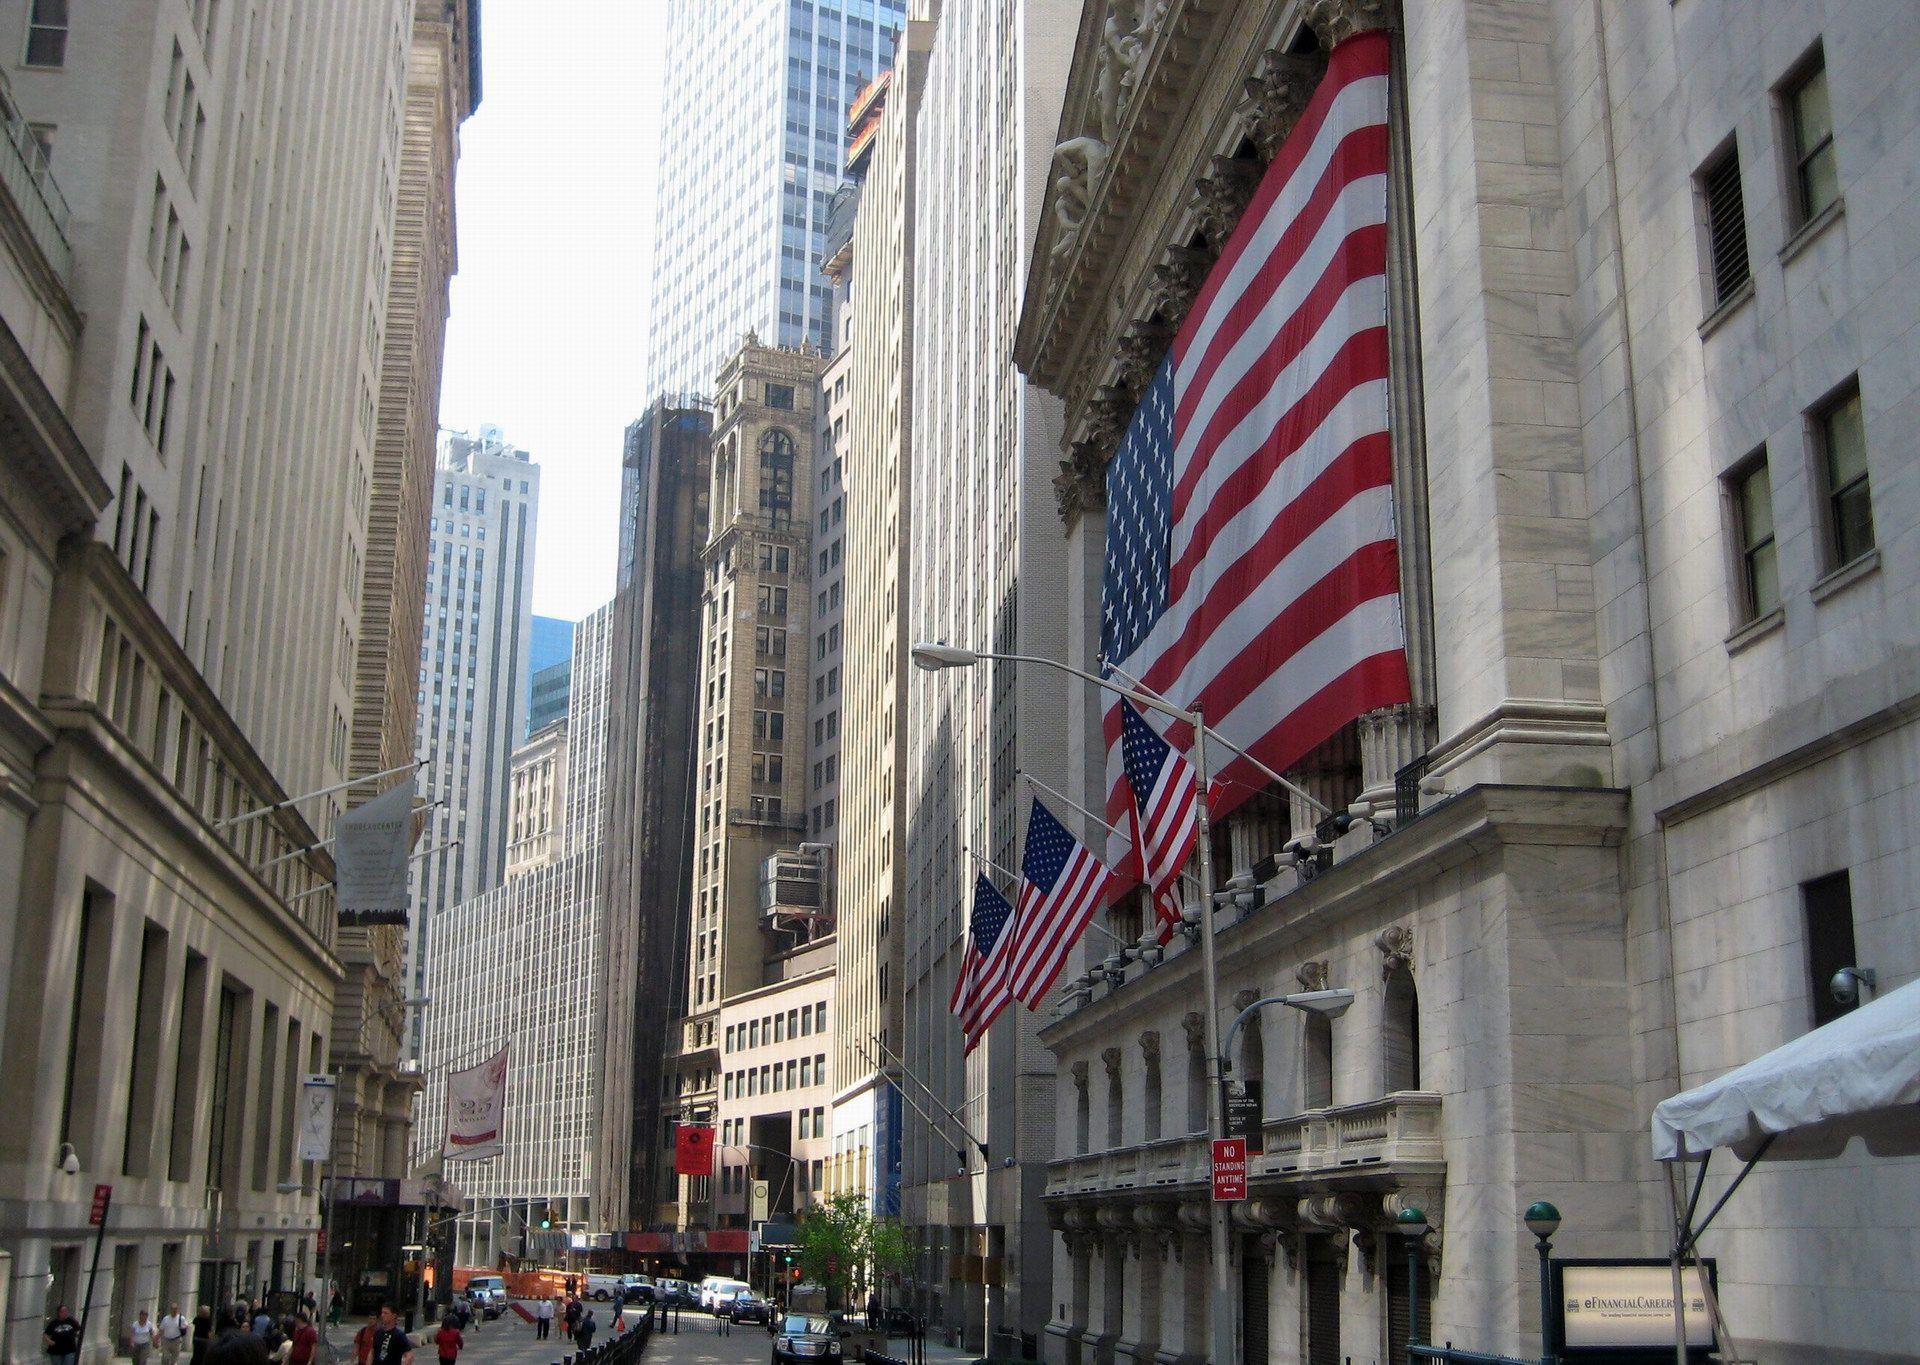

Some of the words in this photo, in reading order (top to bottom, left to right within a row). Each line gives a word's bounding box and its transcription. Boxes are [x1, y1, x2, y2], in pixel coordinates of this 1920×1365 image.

[1223, 1145, 1235, 1158] NO
[1214, 1160, 1245, 1172] STANDING
[1216, 1173, 1243, 1184] ANYTIME
